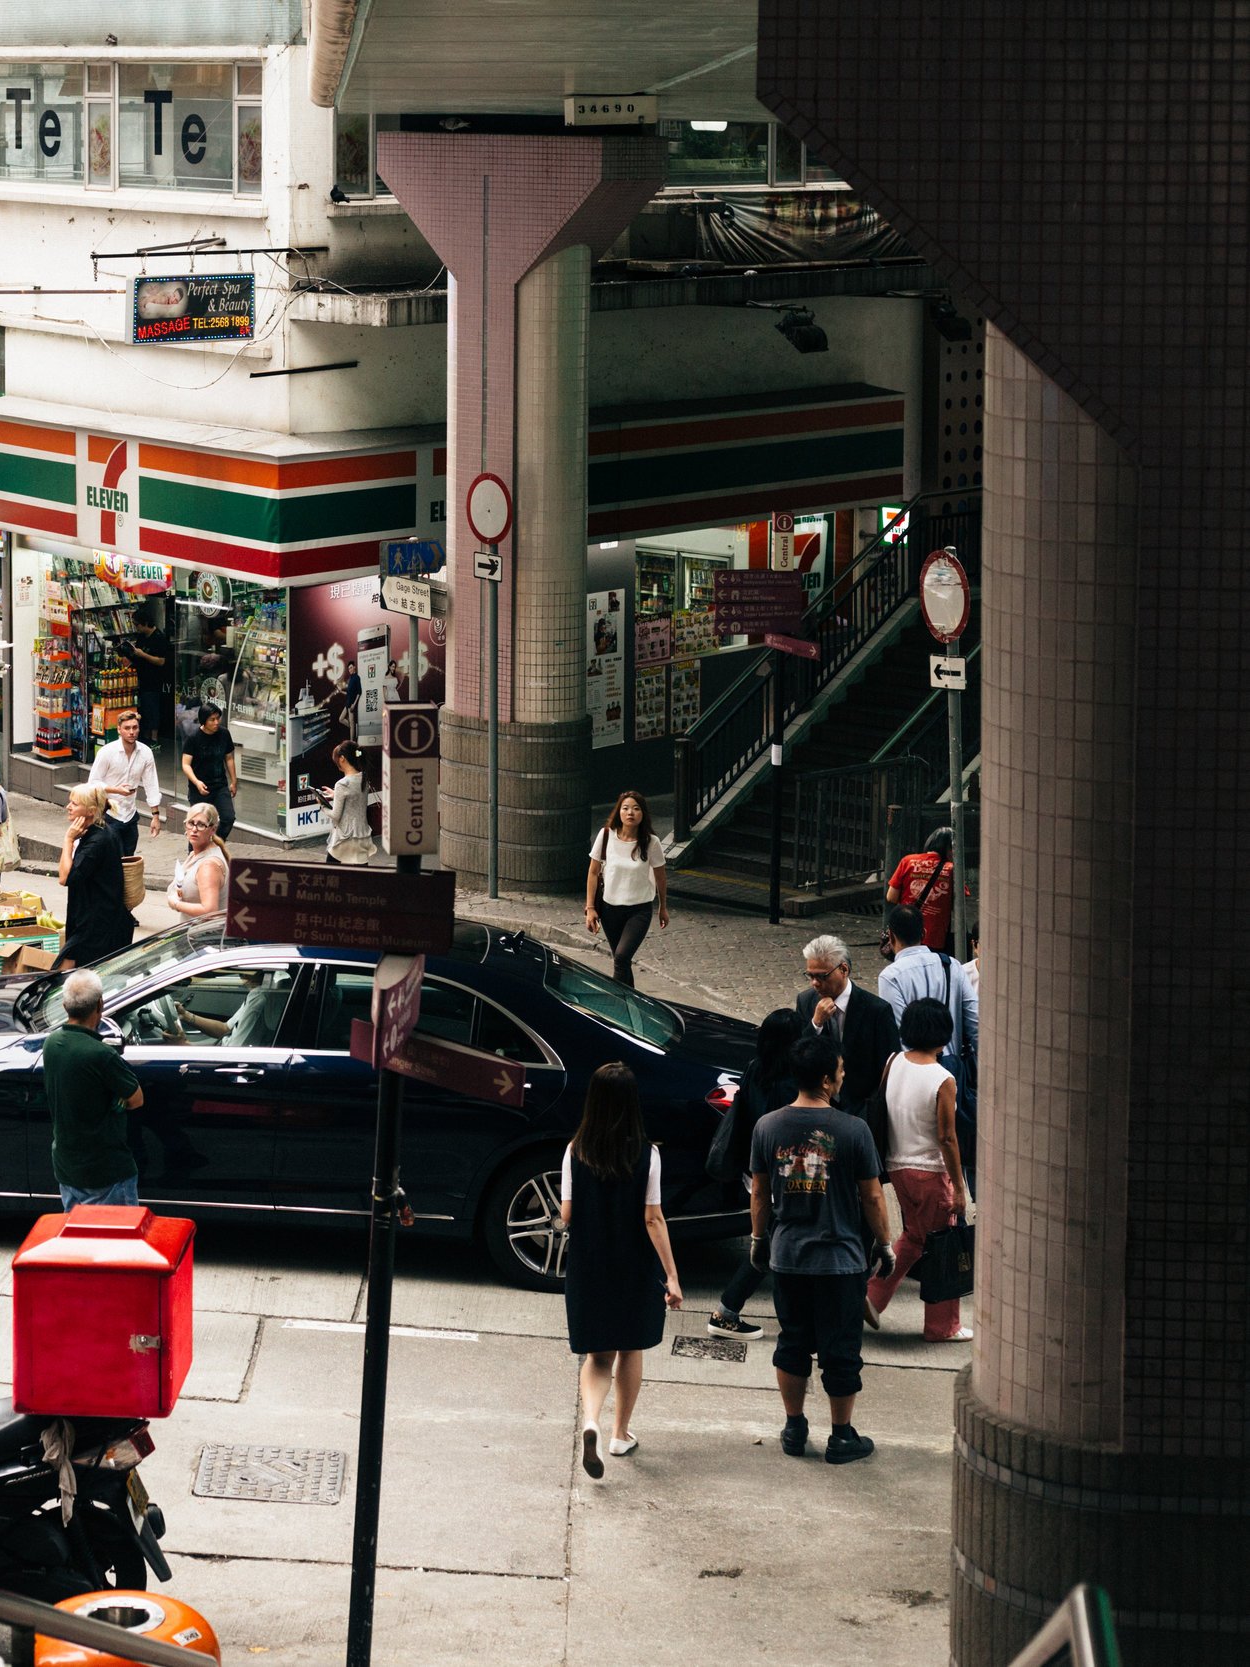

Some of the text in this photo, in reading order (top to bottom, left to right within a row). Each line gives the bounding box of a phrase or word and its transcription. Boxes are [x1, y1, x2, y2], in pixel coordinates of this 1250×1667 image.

[5, 87, 61, 157] Te
[143, 89, 207, 164] Te
[187, 280, 241, 300] Perfect Spa
[218, 298, 251, 315] Beauty
[137, 317, 191, 339] MASSAGE
[231, 315, 250, 326] 1899
[86, 485, 128, 513] ELEVEn
[780, 536, 788, 568] Central
[396, 581, 430, 598] Gage Street
[406, 767, 423, 846] Central
[297, 809, 320, 826] HKT
[295, 890, 387, 907] Man Mo Temple
[294, 928, 432, 949] Dr Sun Yat-sen Museum
